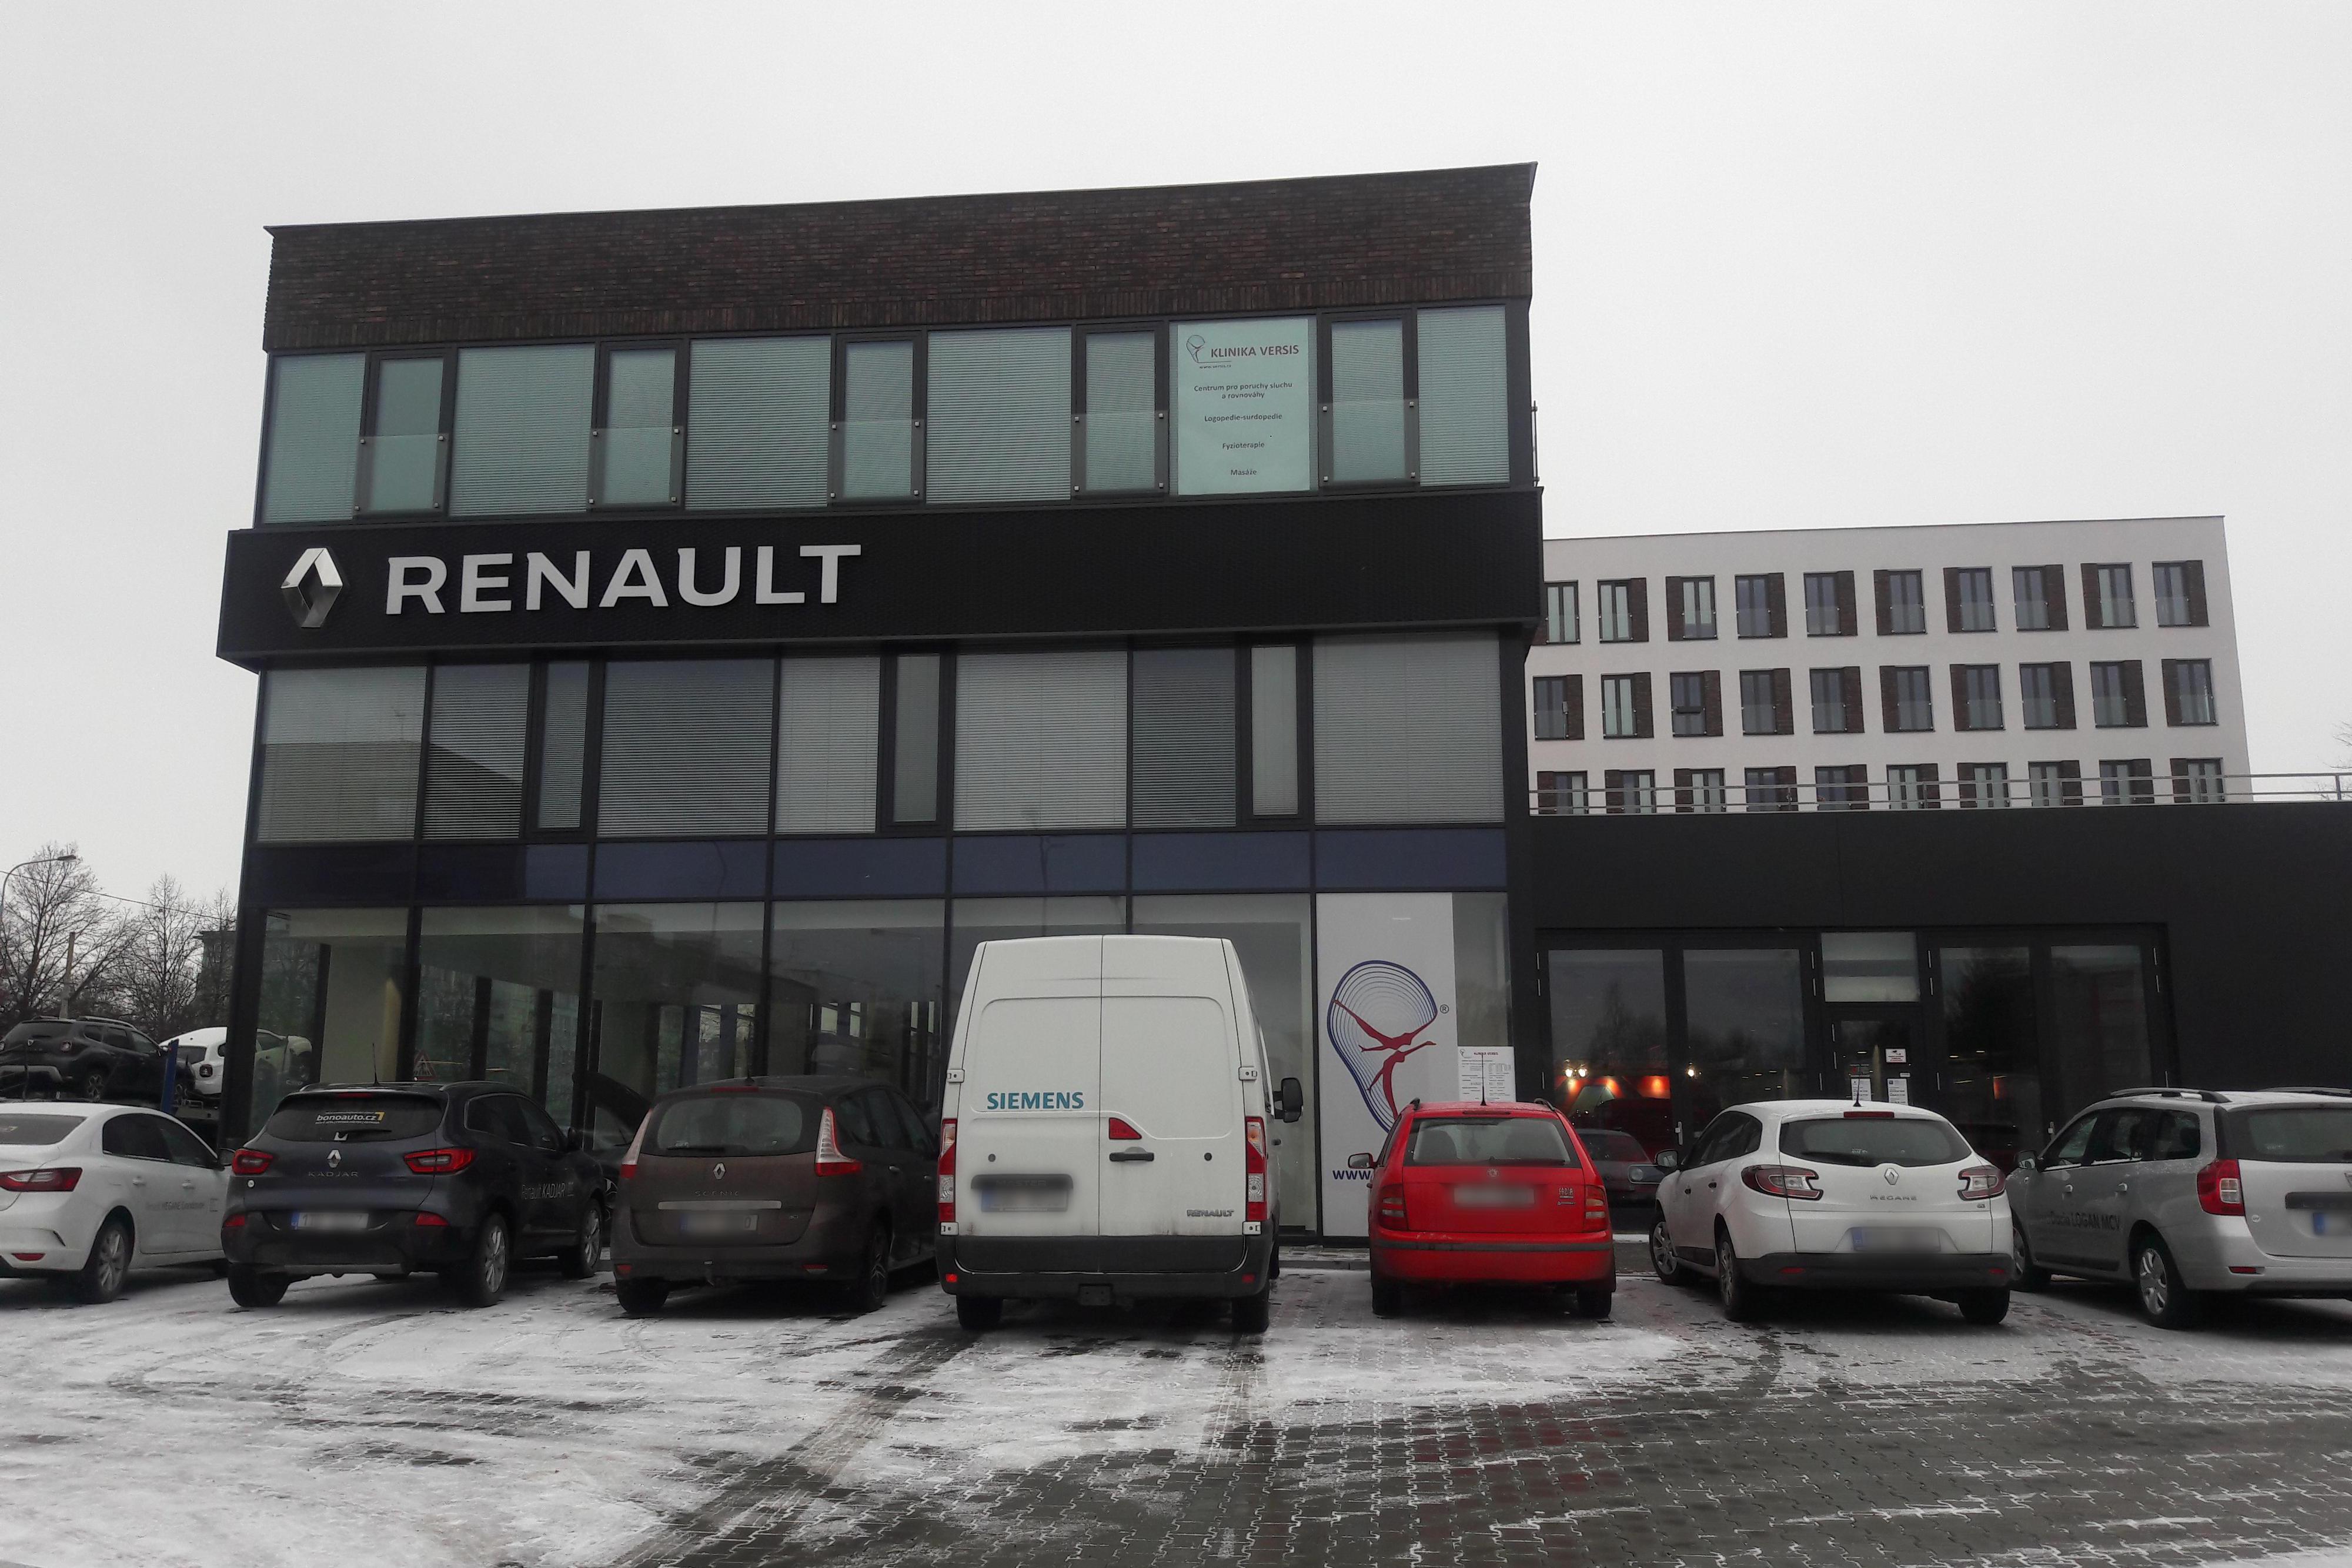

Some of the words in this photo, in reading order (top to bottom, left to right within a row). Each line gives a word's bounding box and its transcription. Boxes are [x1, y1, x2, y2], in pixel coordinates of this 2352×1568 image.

[1211, 347, 1257, 358] KLINIKA
[1260, 345, 1299, 356] VERSIS
[1240, 383, 1268, 391] poruchy
[1204, 413, 1282, 423] Logopedie-surdopedie
[1222, 442, 1265, 450] Fyzioterapie
[386, 544, 862, 615] RENAULT
[987, 1092, 1084, 1109] SIEMENS
[542, 1182, 565, 1199] KADJAR
[1187, 1209, 1235, 1217] RENAULT
[2072, 1212, 2100, 1229] LOGAN
[2102, 1214, 2120, 1231] MCV
